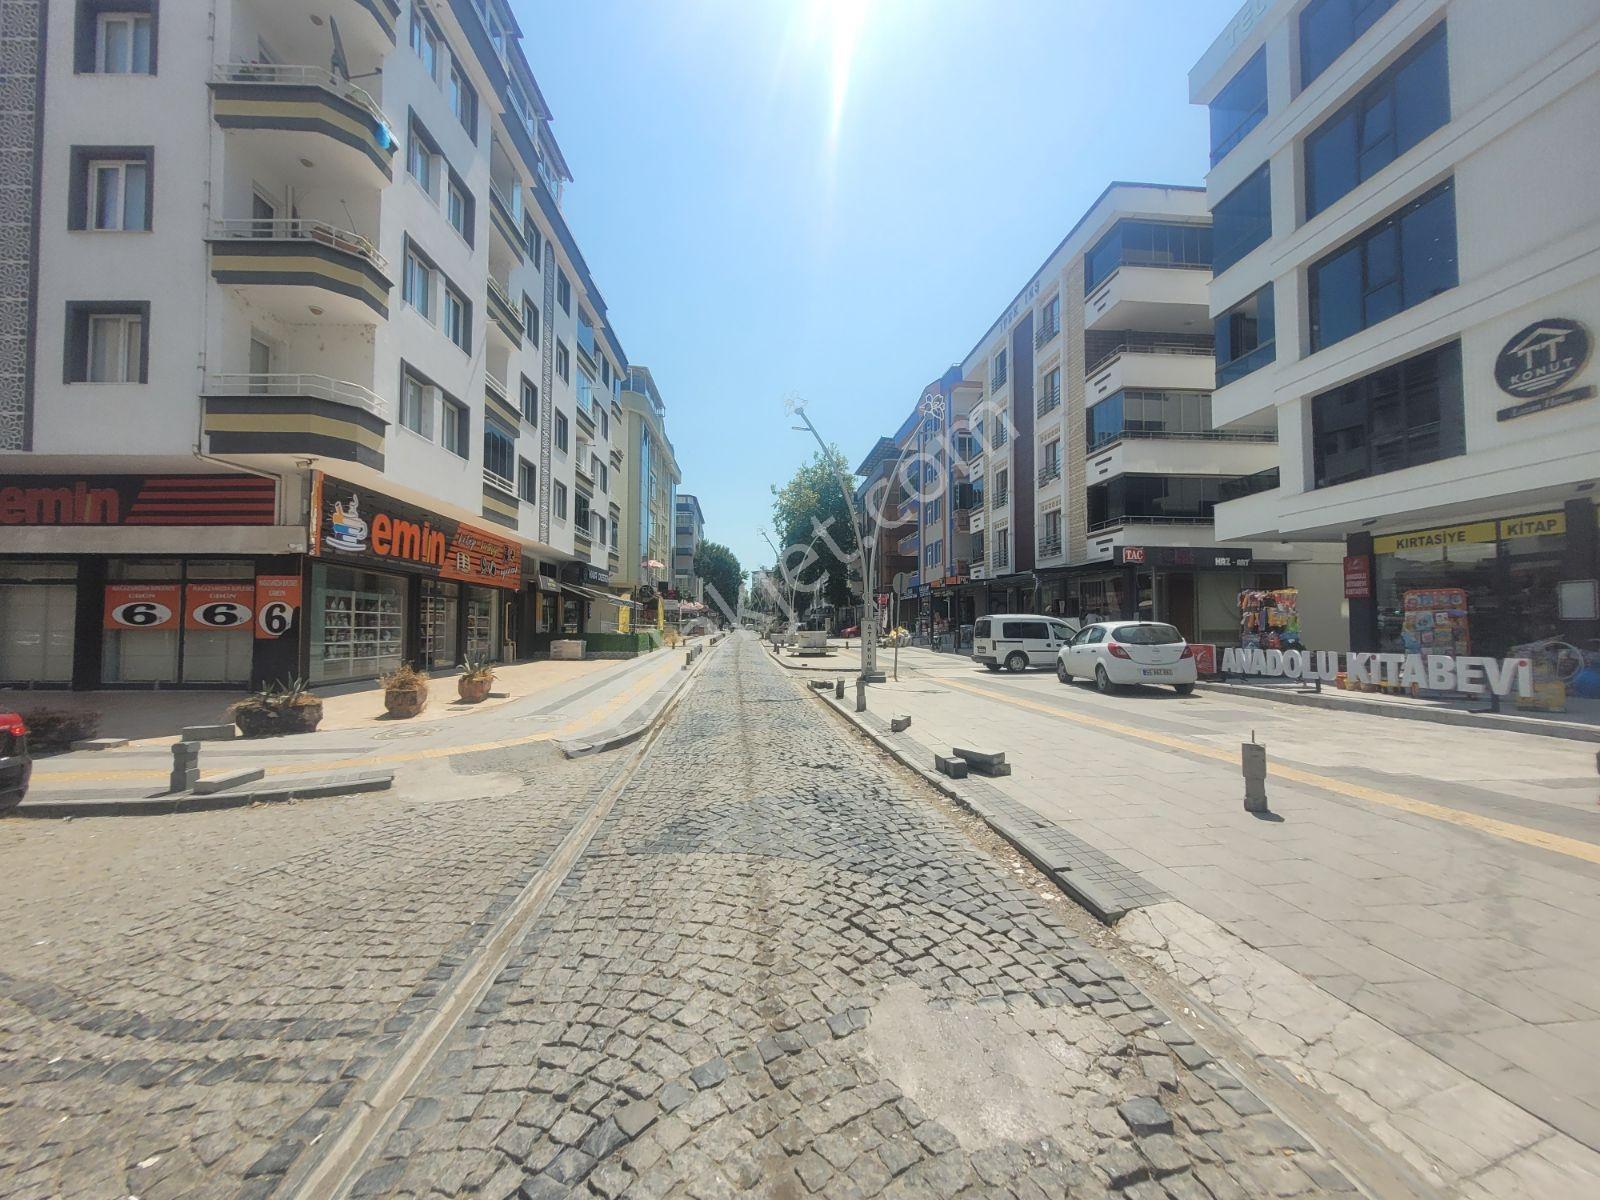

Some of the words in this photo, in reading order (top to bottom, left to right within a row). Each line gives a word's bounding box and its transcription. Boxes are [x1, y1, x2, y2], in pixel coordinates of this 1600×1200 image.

[1510, 356, 1574, 385] KONUT
[371, 512, 446, 566] emin
[1396, 530, 1466, 549] KIRTASİYE
[1507, 519, 1557, 536] KİTAP
[122, 603, 158, 626] 6
[202, 603, 239, 626] 6
[265, 604, 287, 634] 6
[1221, 647, 1338, 681] ANADOLU
[1346, 652, 1534, 698] KİTABEVİ
